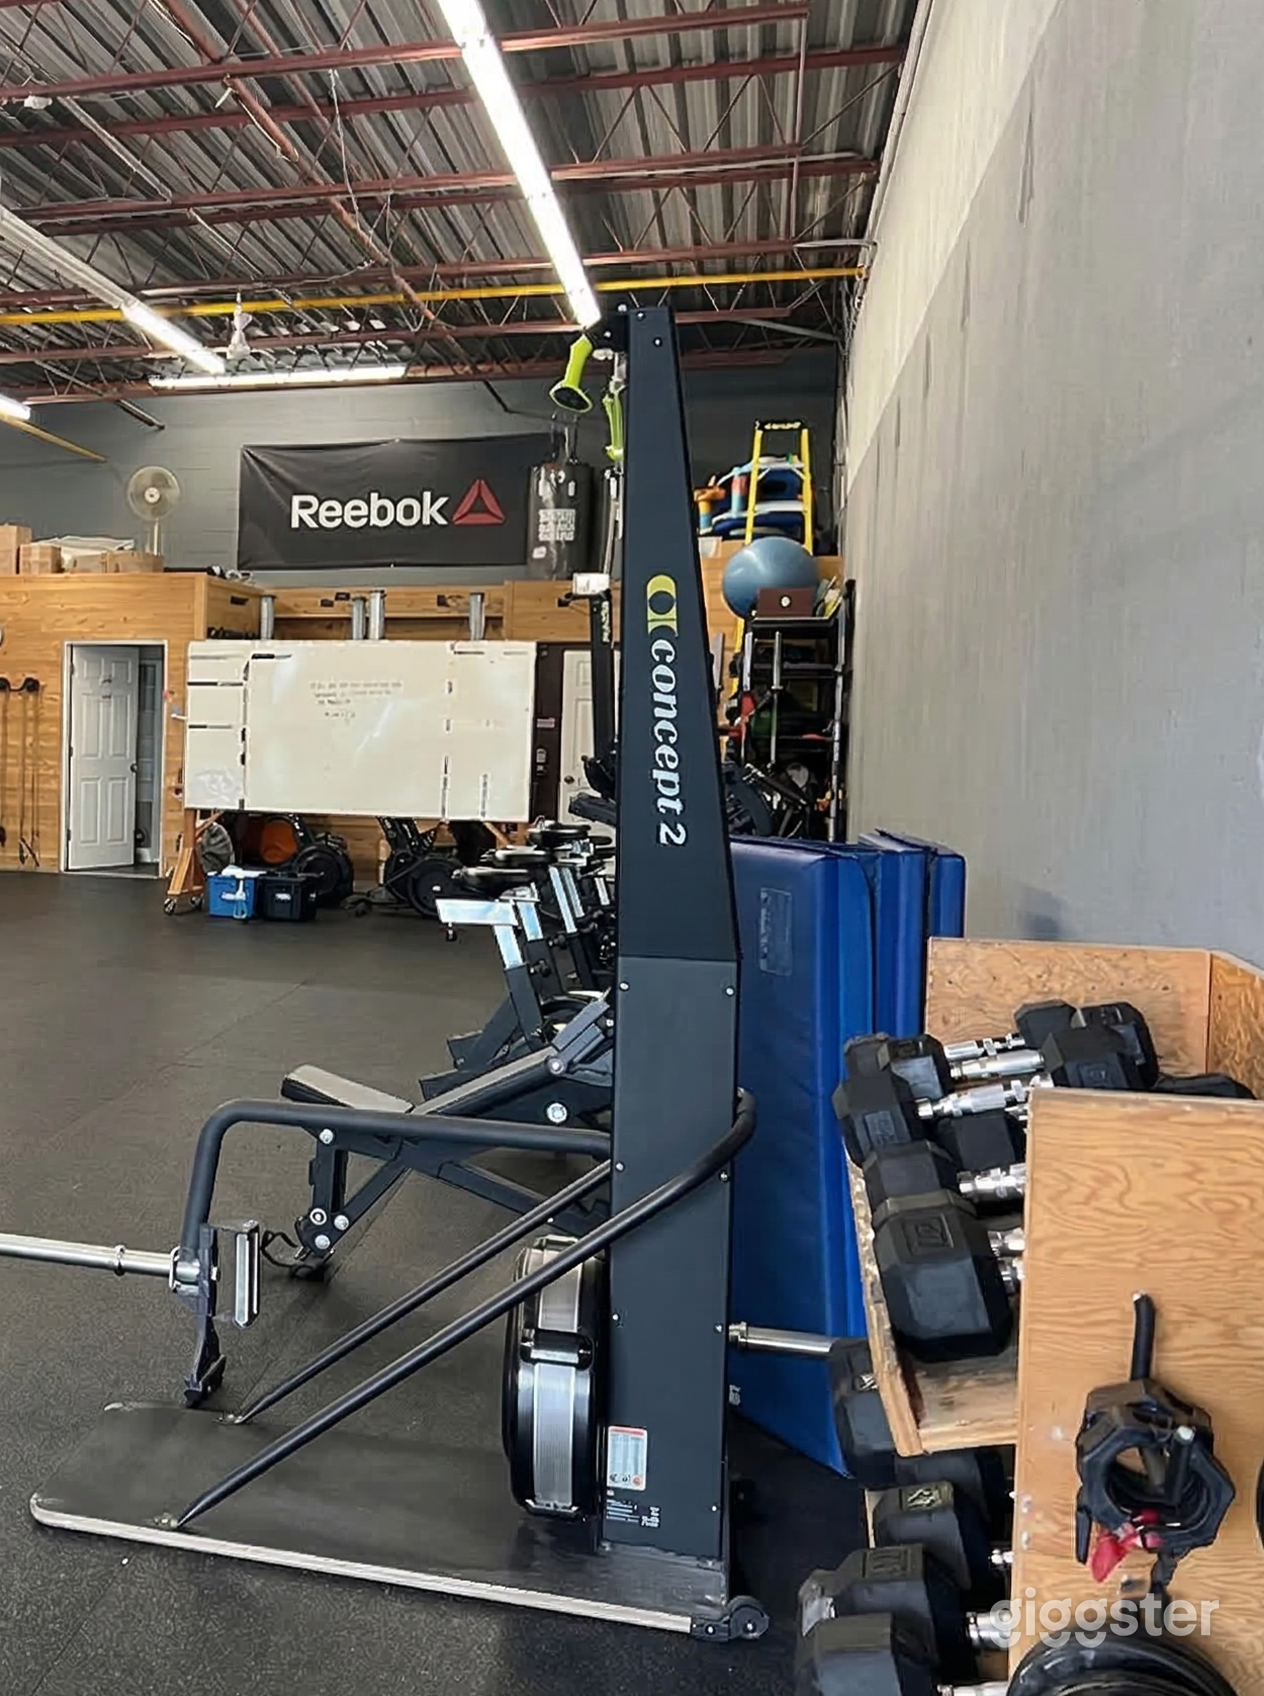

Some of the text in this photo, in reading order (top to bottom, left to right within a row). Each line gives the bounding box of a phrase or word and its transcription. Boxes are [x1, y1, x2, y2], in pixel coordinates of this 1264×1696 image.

[290, 491, 449, 529] Reebok
[650, 638, 687, 847] concept 2
